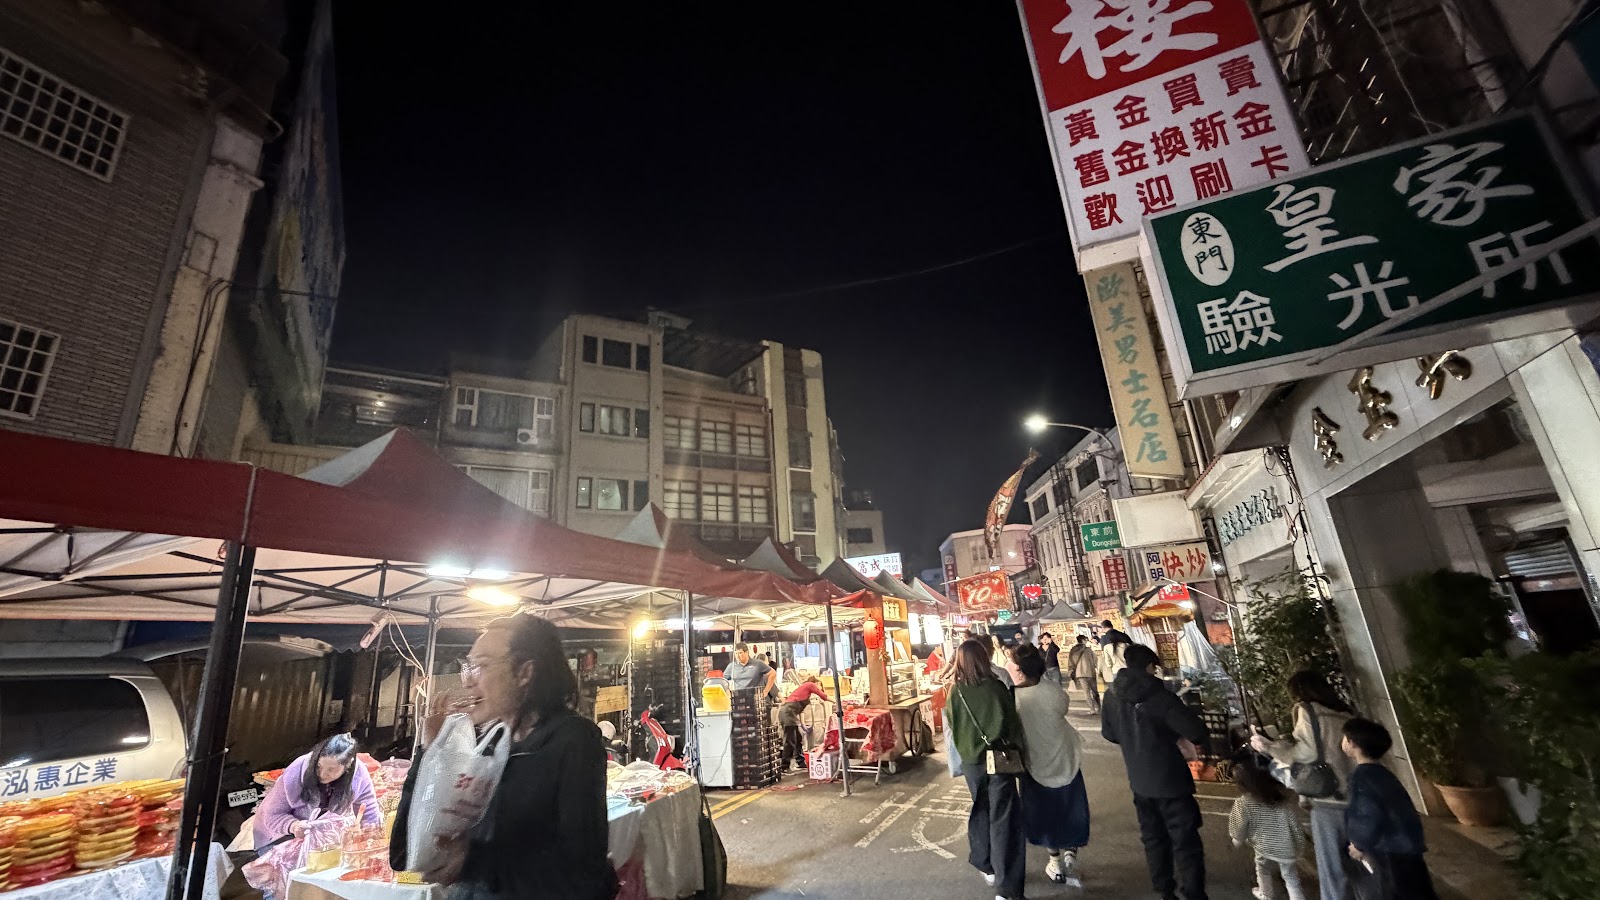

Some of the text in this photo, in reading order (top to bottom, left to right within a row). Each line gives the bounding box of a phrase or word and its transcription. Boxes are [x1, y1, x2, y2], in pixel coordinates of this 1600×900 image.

[1064, 54, 1261, 147] 黃金買賣
[1074, 103, 1276, 188] 舊金換新金
[1084, 146, 1290, 231] 歡迎刷卡
[1264, 142, 1534, 273] 皇家
[1188, 213, 1228, 275] 東門
[1198, 221, 1573, 355] 驗光所
[1096, 273, 1168, 464] 歐美男士名店
[1090, 526, 1113, 537] 東前
[1146, 552, 1166, 582] 阿明
[1162, 547, 1207, 578] 快炒
[0, 757, 118, 797] 泓惠企業
